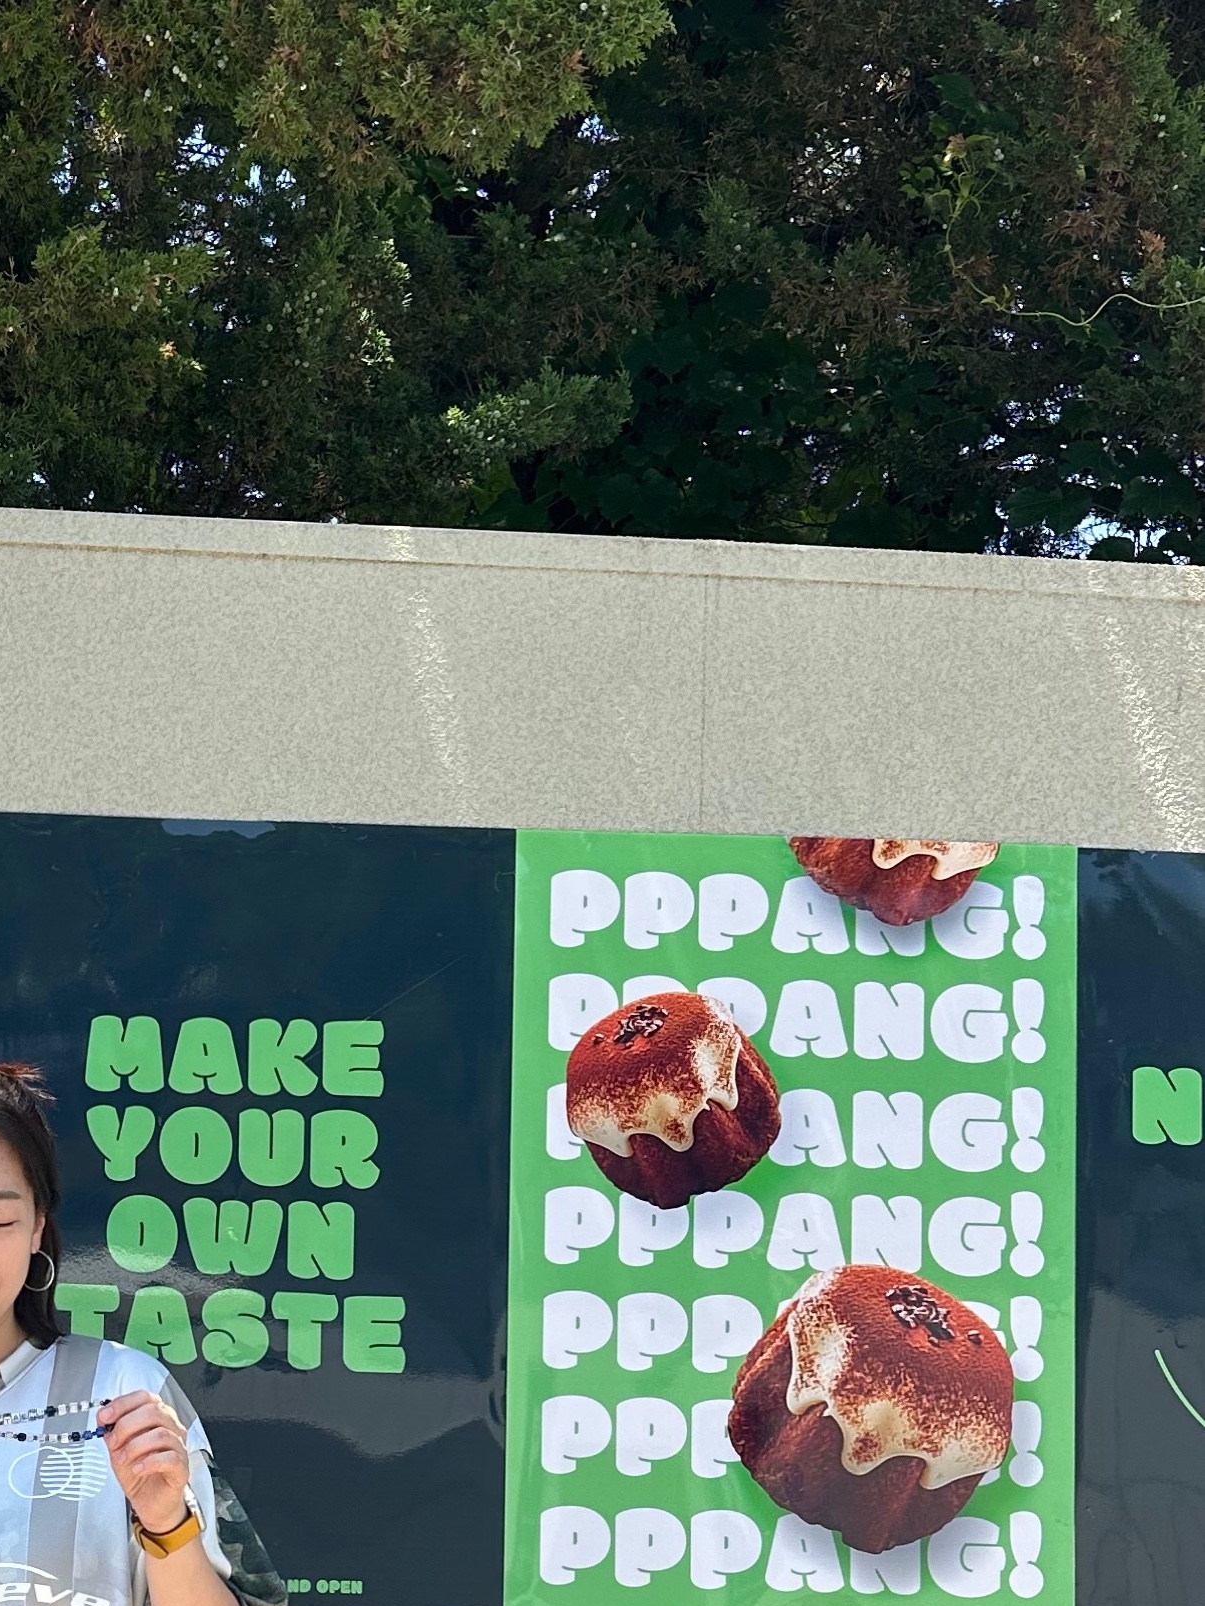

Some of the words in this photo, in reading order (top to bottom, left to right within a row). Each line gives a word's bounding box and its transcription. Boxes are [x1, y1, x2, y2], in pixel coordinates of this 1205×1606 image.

[85, 1015, 384, 1097] MAKE
[548, 972, 1047, 1064] PANG!
[86, 1104, 380, 1189] YOUR
[106, 1194, 355, 1280] OWN
[54, 1282, 406, 1373] TASTE
[316, 1579, 363, 1595] OPEN
